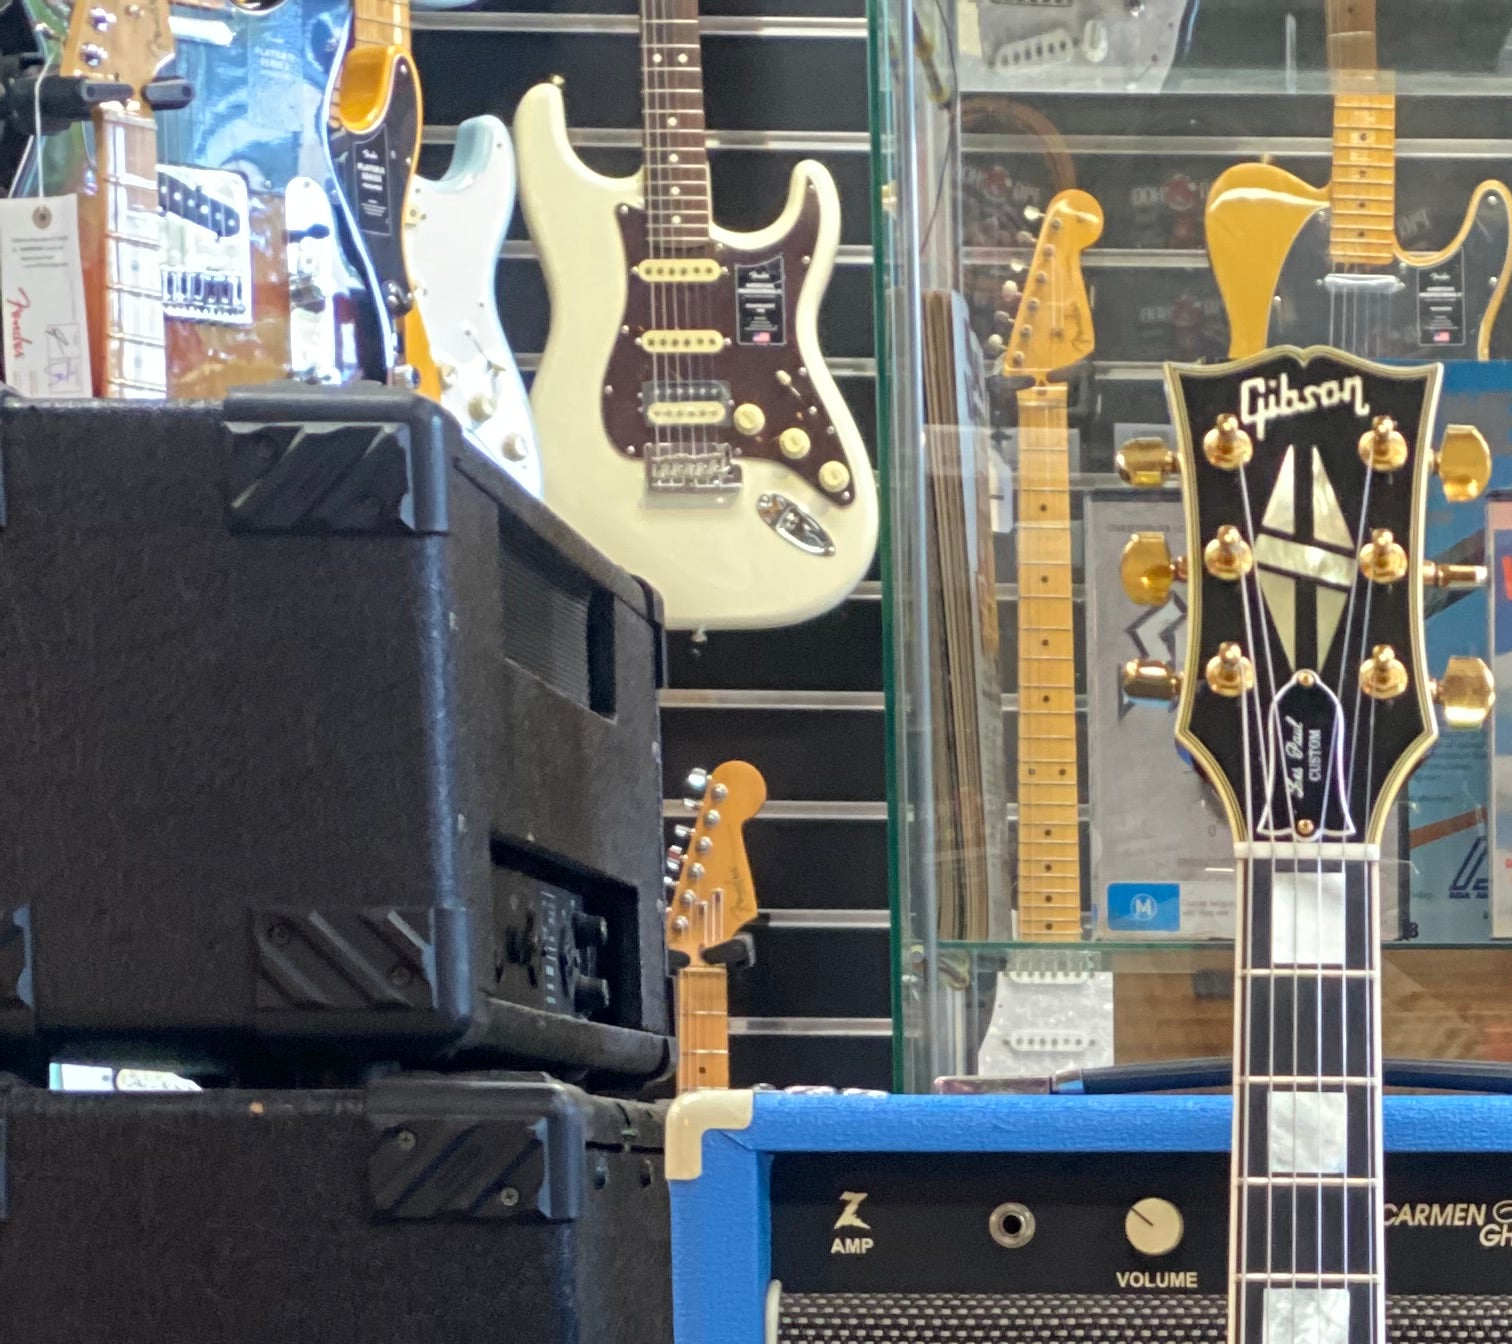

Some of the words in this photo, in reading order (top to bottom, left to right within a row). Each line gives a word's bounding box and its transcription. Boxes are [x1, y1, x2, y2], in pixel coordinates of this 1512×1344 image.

[1241, 372, 1370, 441] Gibson
[1284, 715, 1303, 760] Paul
[1308, 729, 1321, 782] CUSTOM
[1285, 766, 1304, 799] Les
[833, 1191, 871, 1230] Z
[1384, 1203, 1487, 1226] CARMEN
[830, 1237, 874, 1254] AMP
[1116, 1271, 1198, 1288] VOLUME
